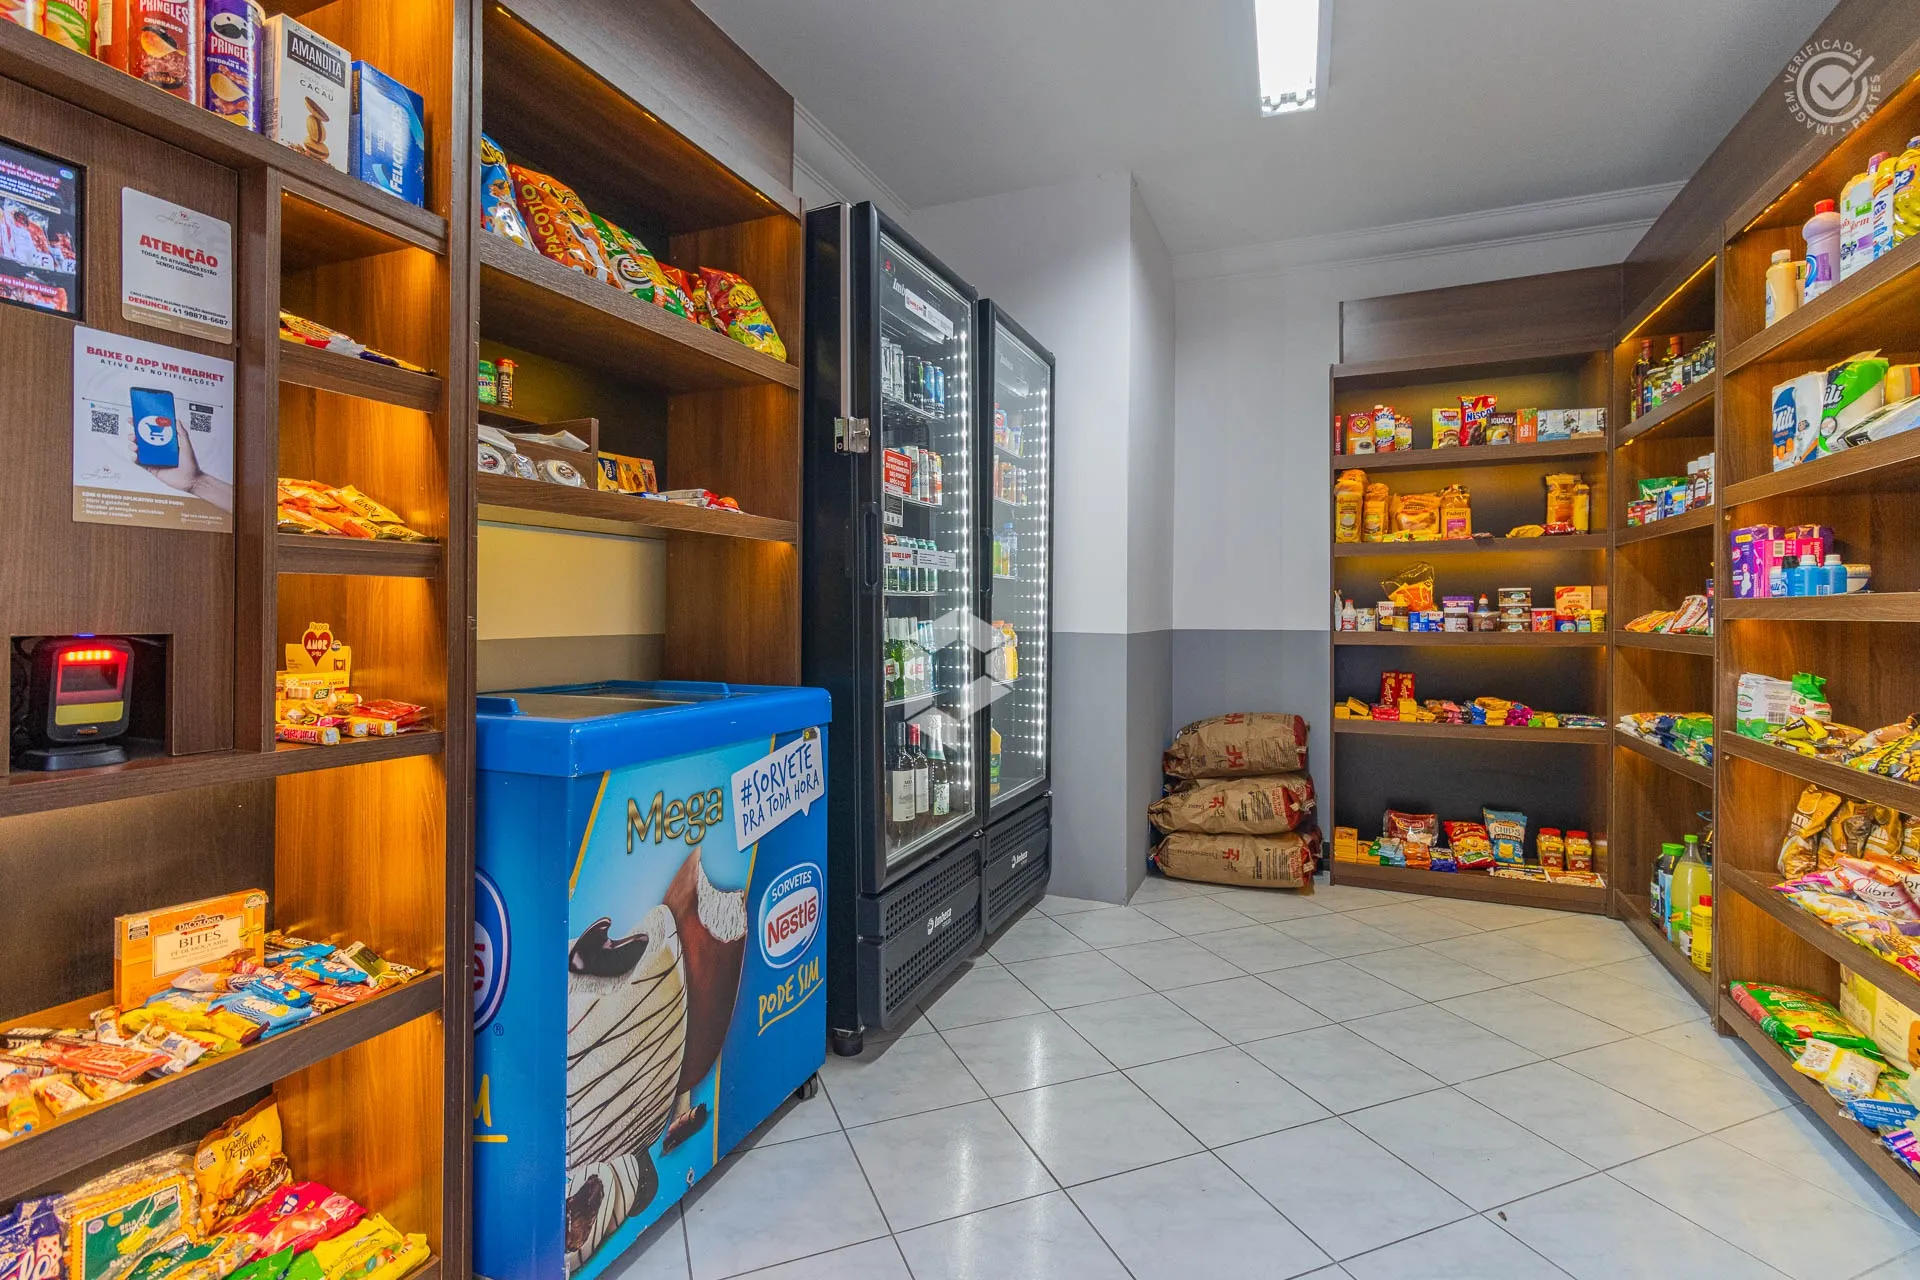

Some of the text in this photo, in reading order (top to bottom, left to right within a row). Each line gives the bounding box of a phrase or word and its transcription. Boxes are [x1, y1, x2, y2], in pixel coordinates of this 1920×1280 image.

[139, 0, 190, 26] PRINGLES
[143, 17, 184, 34] CHURRASCO
[209, 35, 252, 64] PRINGLE
[291, 37, 343, 79] AMANDITA
[299, 79, 334, 102] CACAU
[521, 184, 564, 253] PACOTÃO
[139, 234, 219, 268] ATENÇÃO
[141, 250, 160, 260] TODAS
[168, 258, 200, 271] ATIVIDADES
[200, 266, 218, 277] ESTÃO
[155, 260, 204, 278] SENDO GRAVADAS
[128, 295, 172, 313] DENUNCIE:
[172, 307, 182, 315] 41
[86, 346, 225, 382] BAIXE O APP VM MARKET
[100, 358, 216, 387] ATIVE AS NOTIFICAÇÕES
[1823, 383, 1845, 405] ili
[1773, 406, 1795, 432] Mili
[305, 638, 329, 650] AMOR
[740, 743, 814, 808] #SORVETE
[742, 772, 820, 836] PRA TODA HORA
[625, 786, 725, 855] Mega
[1493, 825, 1522, 837] CHIPS
[770, 870, 813, 902] SORVETES
[766, 895, 818, 949] Nestlé
[179, 931, 222, 949] BITES
[758, 956, 820, 1026] PODE SIM
[232, 1133, 267, 1160] Toffees
